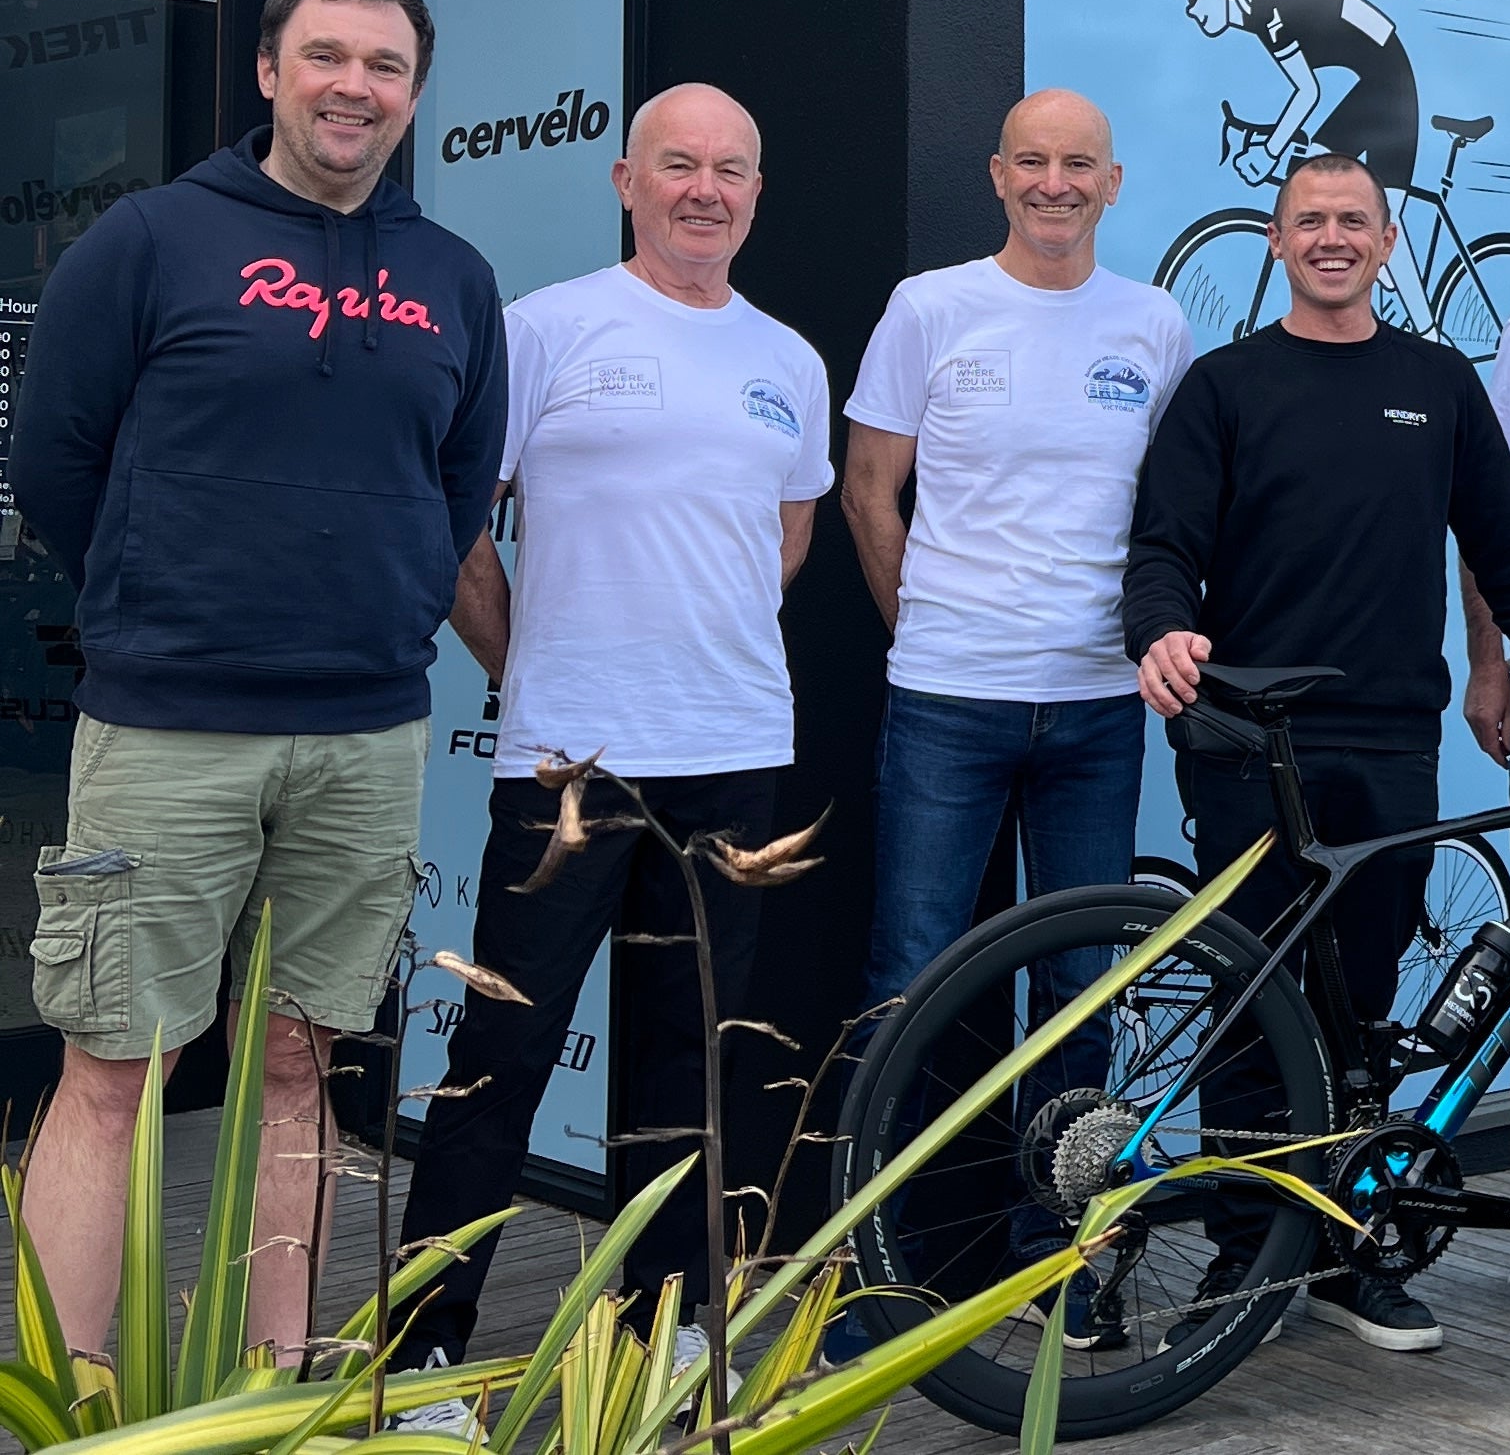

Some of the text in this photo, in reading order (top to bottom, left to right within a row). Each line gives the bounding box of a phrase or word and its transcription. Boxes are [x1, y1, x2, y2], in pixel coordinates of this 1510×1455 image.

[442, 89, 609, 163] cervélo
[957, 361, 981, 369] GIVE
[956, 369, 995, 377] WHERE
[629, 382, 656, 390] LIVE
[956, 378, 1005, 386] YOU LIVE
